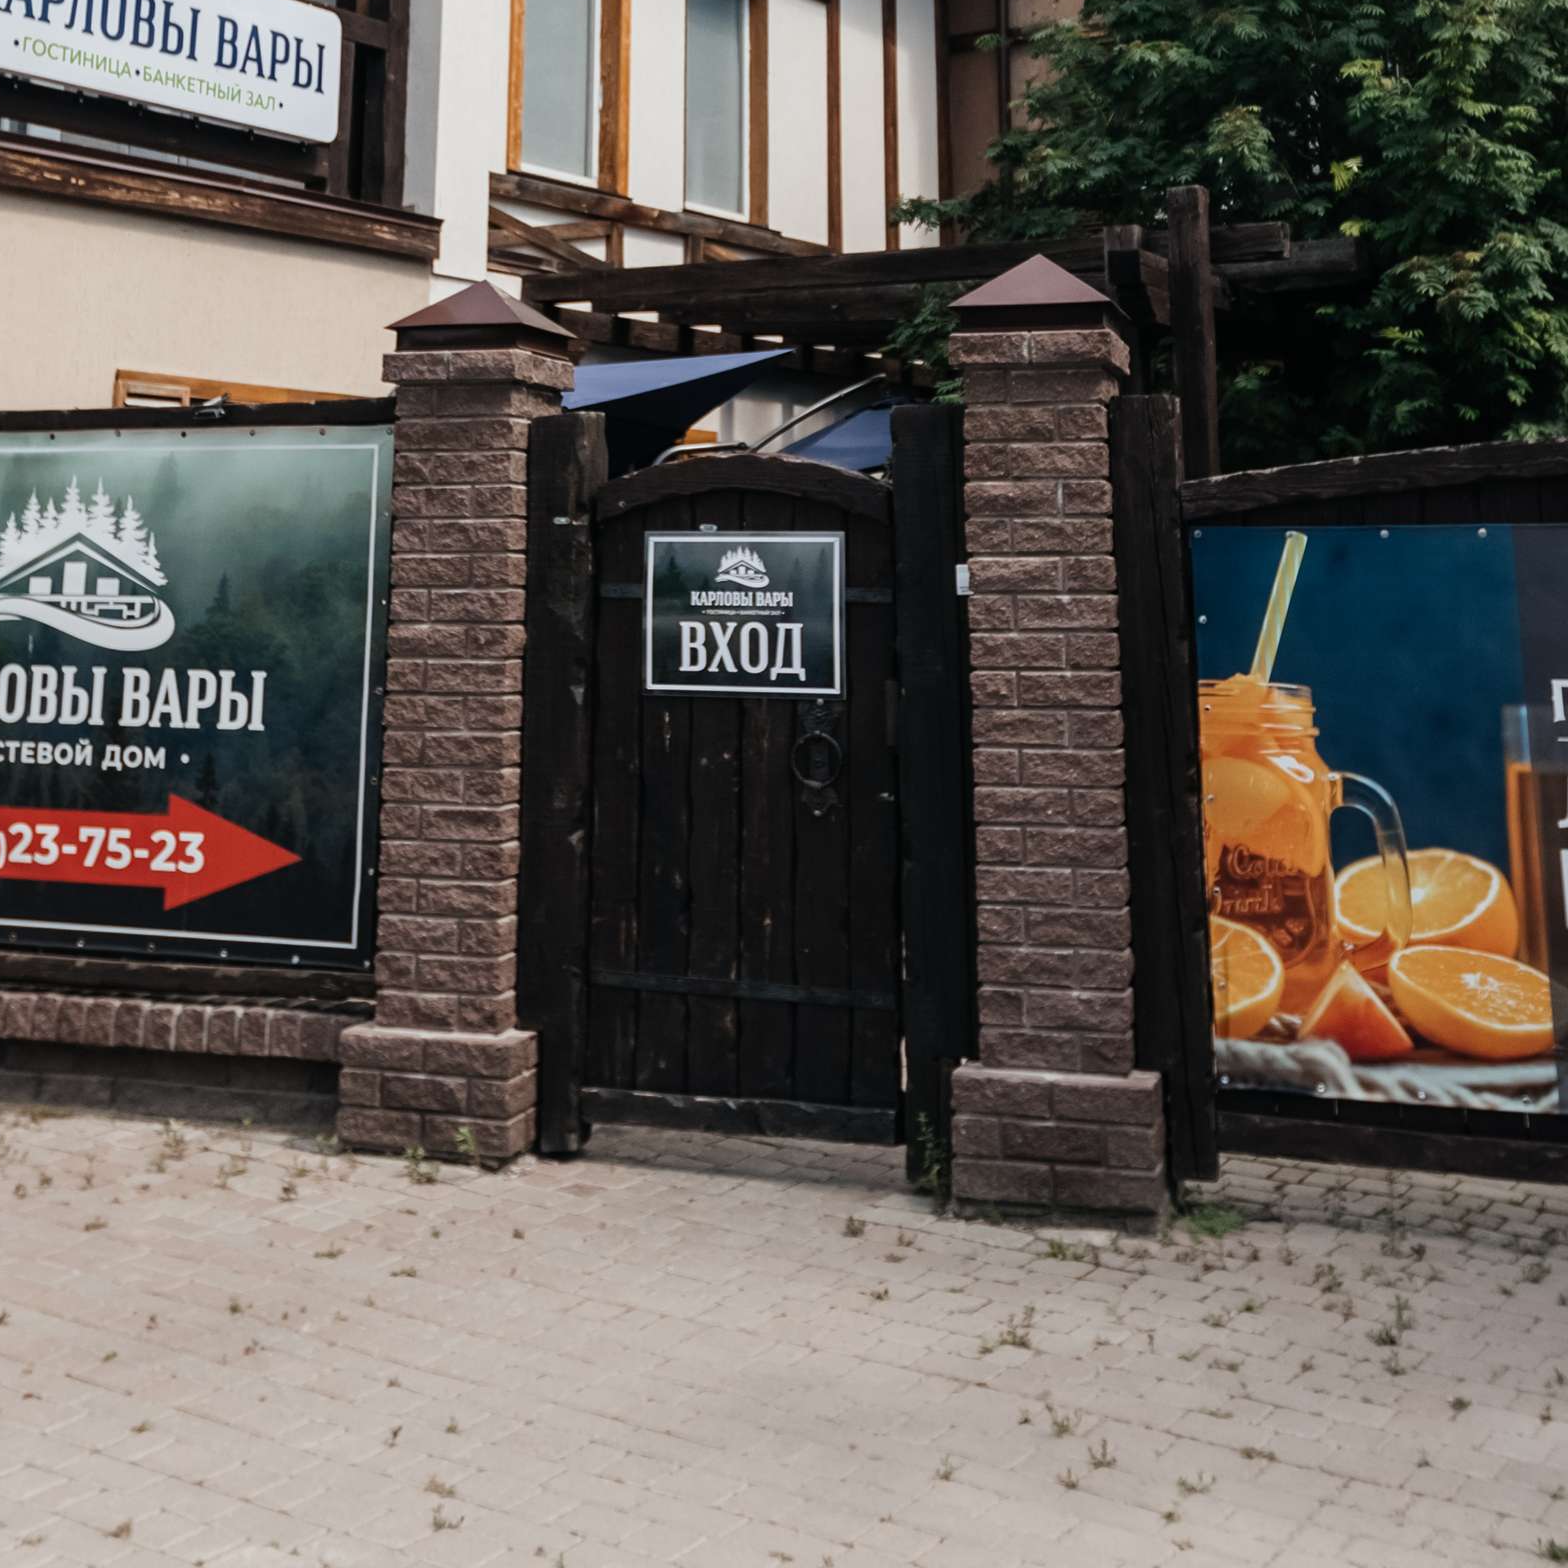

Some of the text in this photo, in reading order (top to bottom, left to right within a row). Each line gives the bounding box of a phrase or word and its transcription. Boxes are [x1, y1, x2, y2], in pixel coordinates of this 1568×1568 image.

[23, 36, 276, 113] ГОСТИНИЦА БАНКЕТНЫЙ ЗАЛ
[215, 15, 326, 95] ВАРЫ
[690, 591, 793, 607] КАРЛОВЫ ВАРЫ
[678, 621, 806, 682] ВХОД
[118, 666, 267, 732] ВАРЫ
[101, 746, 166, 772] ДОМ
